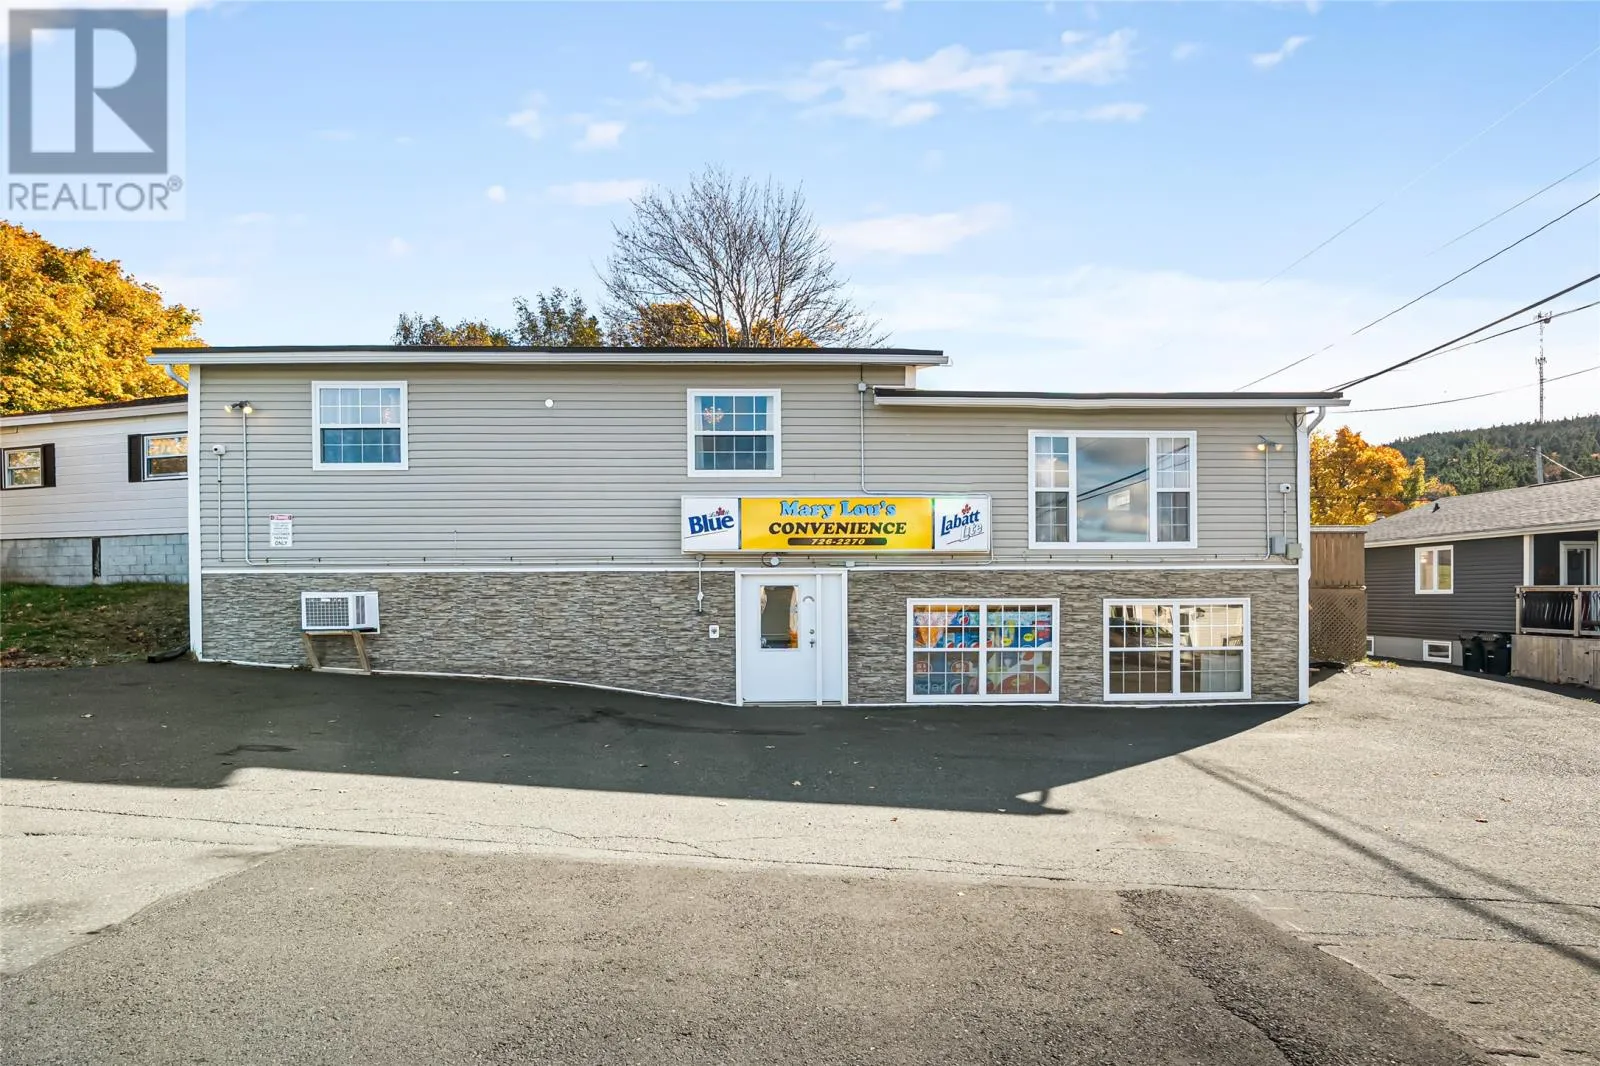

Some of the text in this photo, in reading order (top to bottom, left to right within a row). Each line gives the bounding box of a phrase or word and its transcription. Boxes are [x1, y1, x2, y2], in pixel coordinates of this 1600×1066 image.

[780, 500, 896, 519] Mary Lou's
[688, 514, 735, 534] Blue
[768, 522, 907, 535] CONVENIENCE
[941, 510, 980, 536] Labatt
